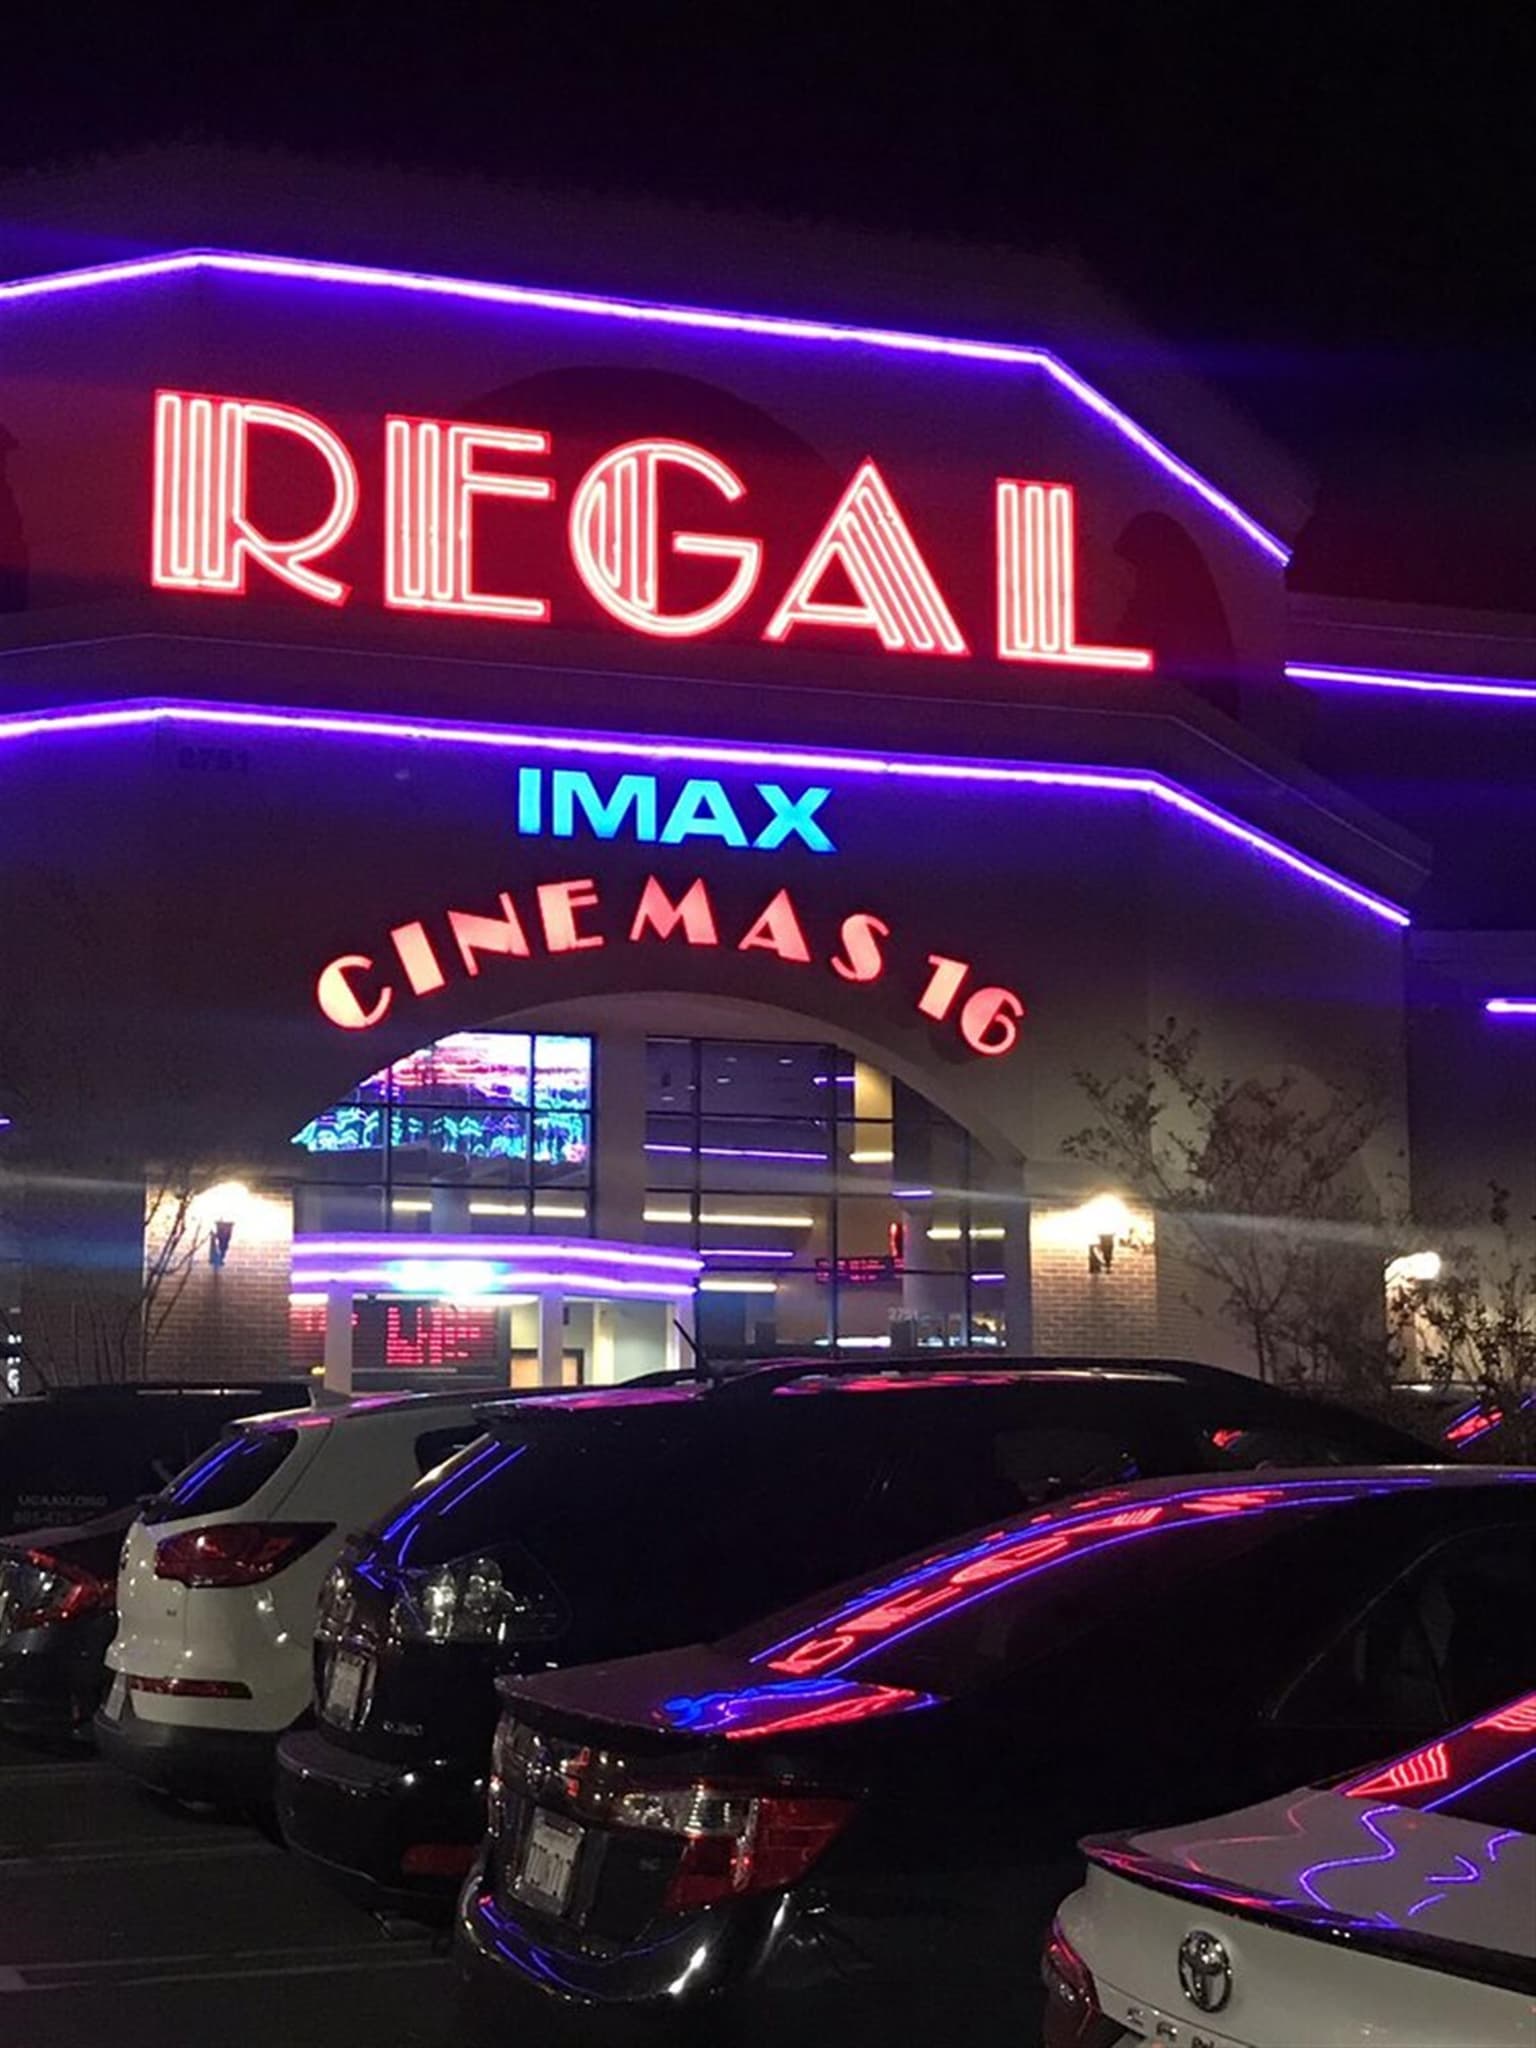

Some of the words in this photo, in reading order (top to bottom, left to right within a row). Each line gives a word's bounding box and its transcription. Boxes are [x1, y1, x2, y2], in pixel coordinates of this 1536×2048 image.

[151, 388, 1155, 671] REGAL
[517, 767, 838, 853] IMAX
[316, 874, 890, 1030] CINEMAS
[916, 953, 1027, 1057] 16
